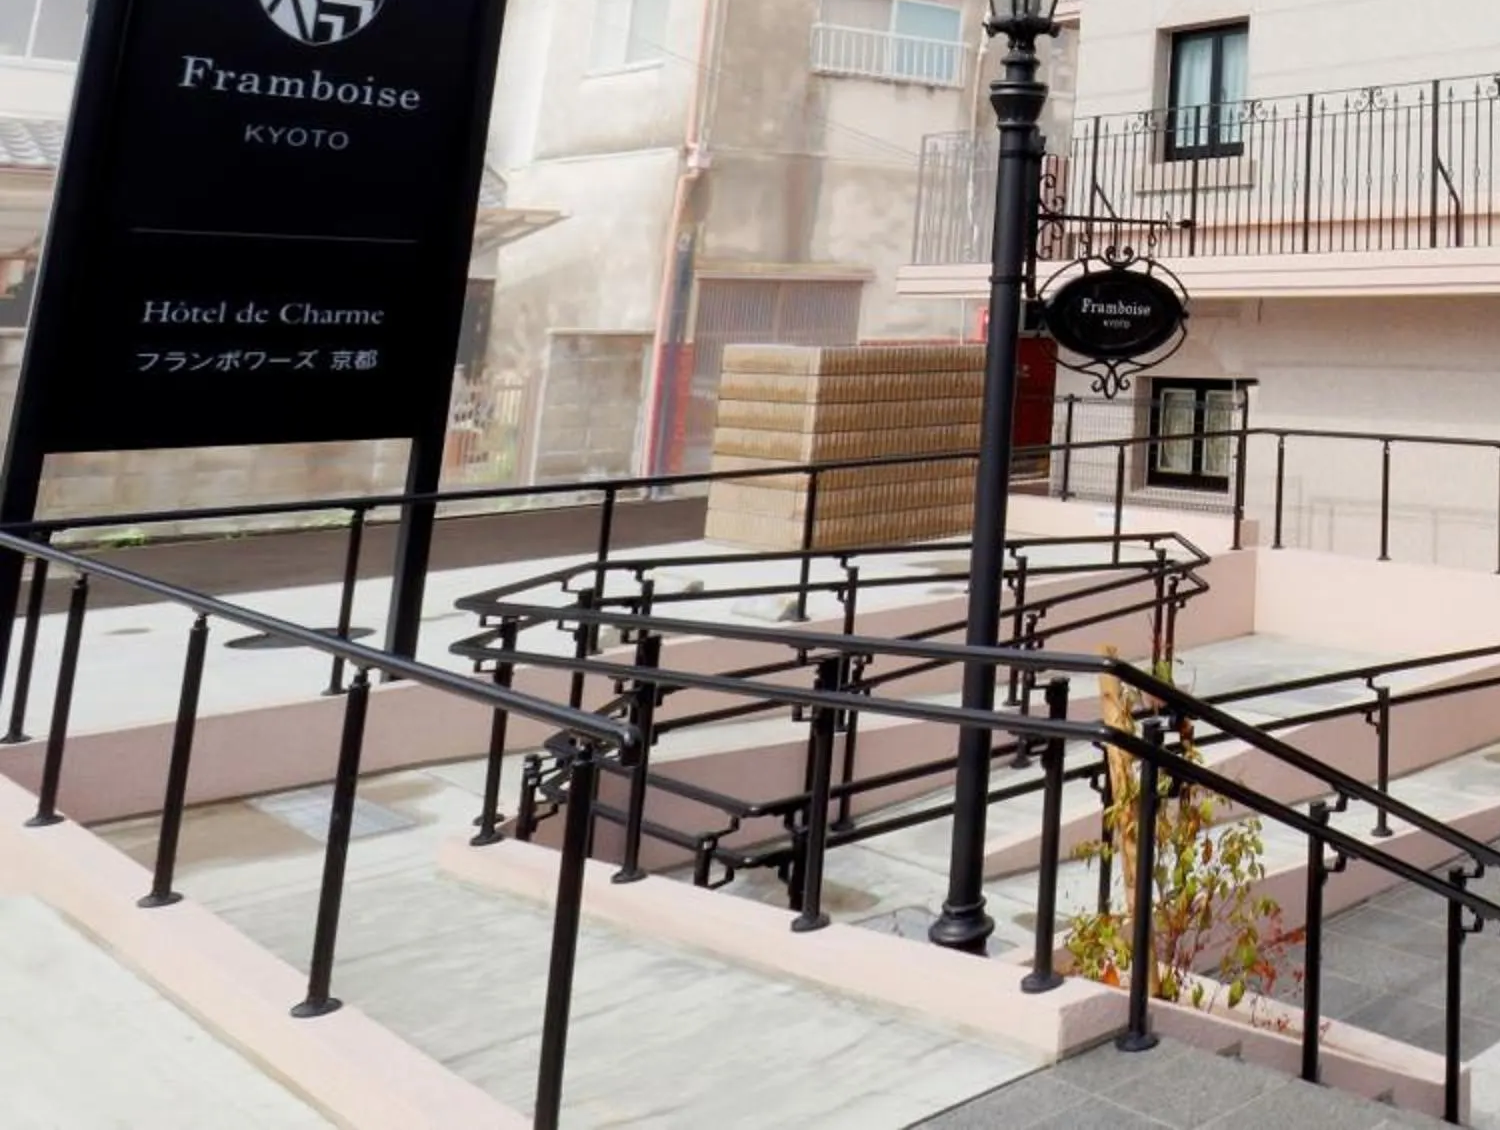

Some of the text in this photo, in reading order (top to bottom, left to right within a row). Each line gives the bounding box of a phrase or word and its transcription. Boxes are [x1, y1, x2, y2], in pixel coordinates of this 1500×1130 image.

[178, 55, 421, 110] Framboise
[244, 124, 349, 150] KYOTO
[142, 300, 385, 325] Hôtel de Charme
[1081, 297, 1151, 317] Framboise
[137, 348, 379, 372] フランボワーズ 京都
